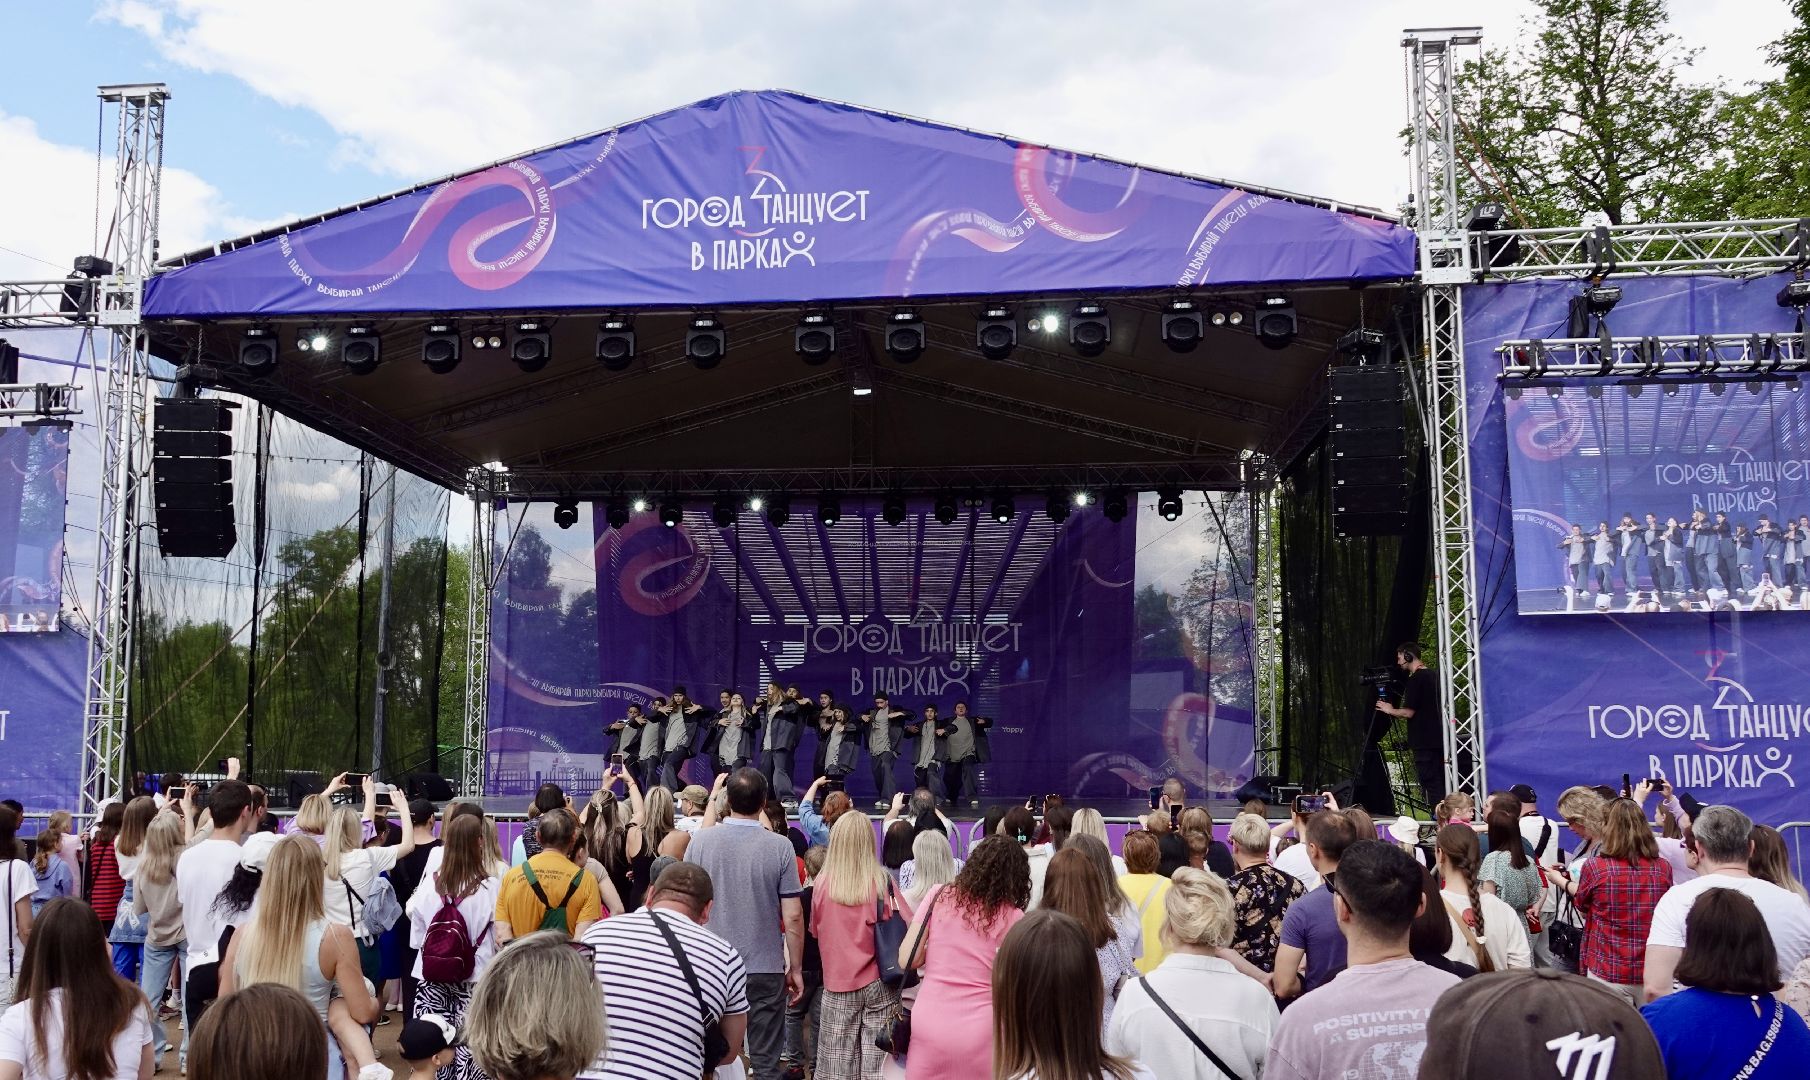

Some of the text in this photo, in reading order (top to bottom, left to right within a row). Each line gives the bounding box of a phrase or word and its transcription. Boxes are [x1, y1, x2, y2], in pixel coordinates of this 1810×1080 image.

[642, 195, 746, 230] ГОРОД
[691, 241, 705, 271] В
[316, 283, 364, 298] ВЫБИРАЙ
[1655, 463, 1727, 485] ГОРОД
[803, 623, 903, 654] ГОРОД
[851, 667, 864, 695] В
[1588, 705, 1710, 740] ГОРОД
[1312, 1008, 1421, 1035] POSITIVITY
